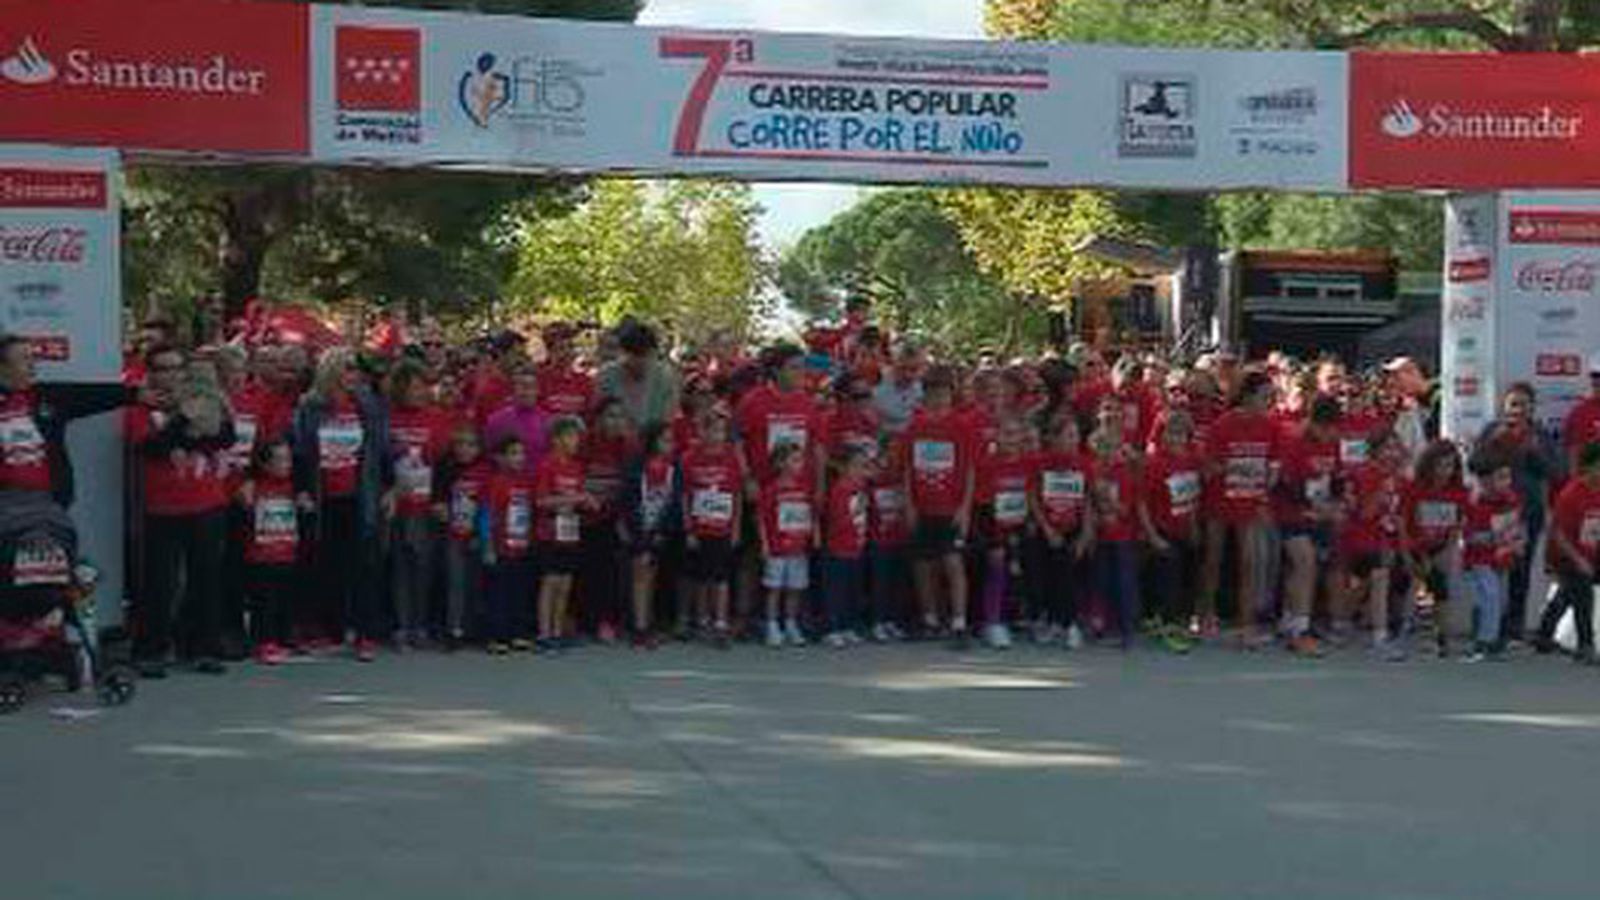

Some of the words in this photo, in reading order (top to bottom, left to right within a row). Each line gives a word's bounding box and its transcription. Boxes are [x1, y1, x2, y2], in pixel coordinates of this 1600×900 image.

[66, 49, 266, 95] Santander
[748, 83, 878, 113] CARRERA
[887, 88, 1016, 117] POPULAR
[914, 121, 952, 152] EL
[1427, 106, 1583, 138] Santander
